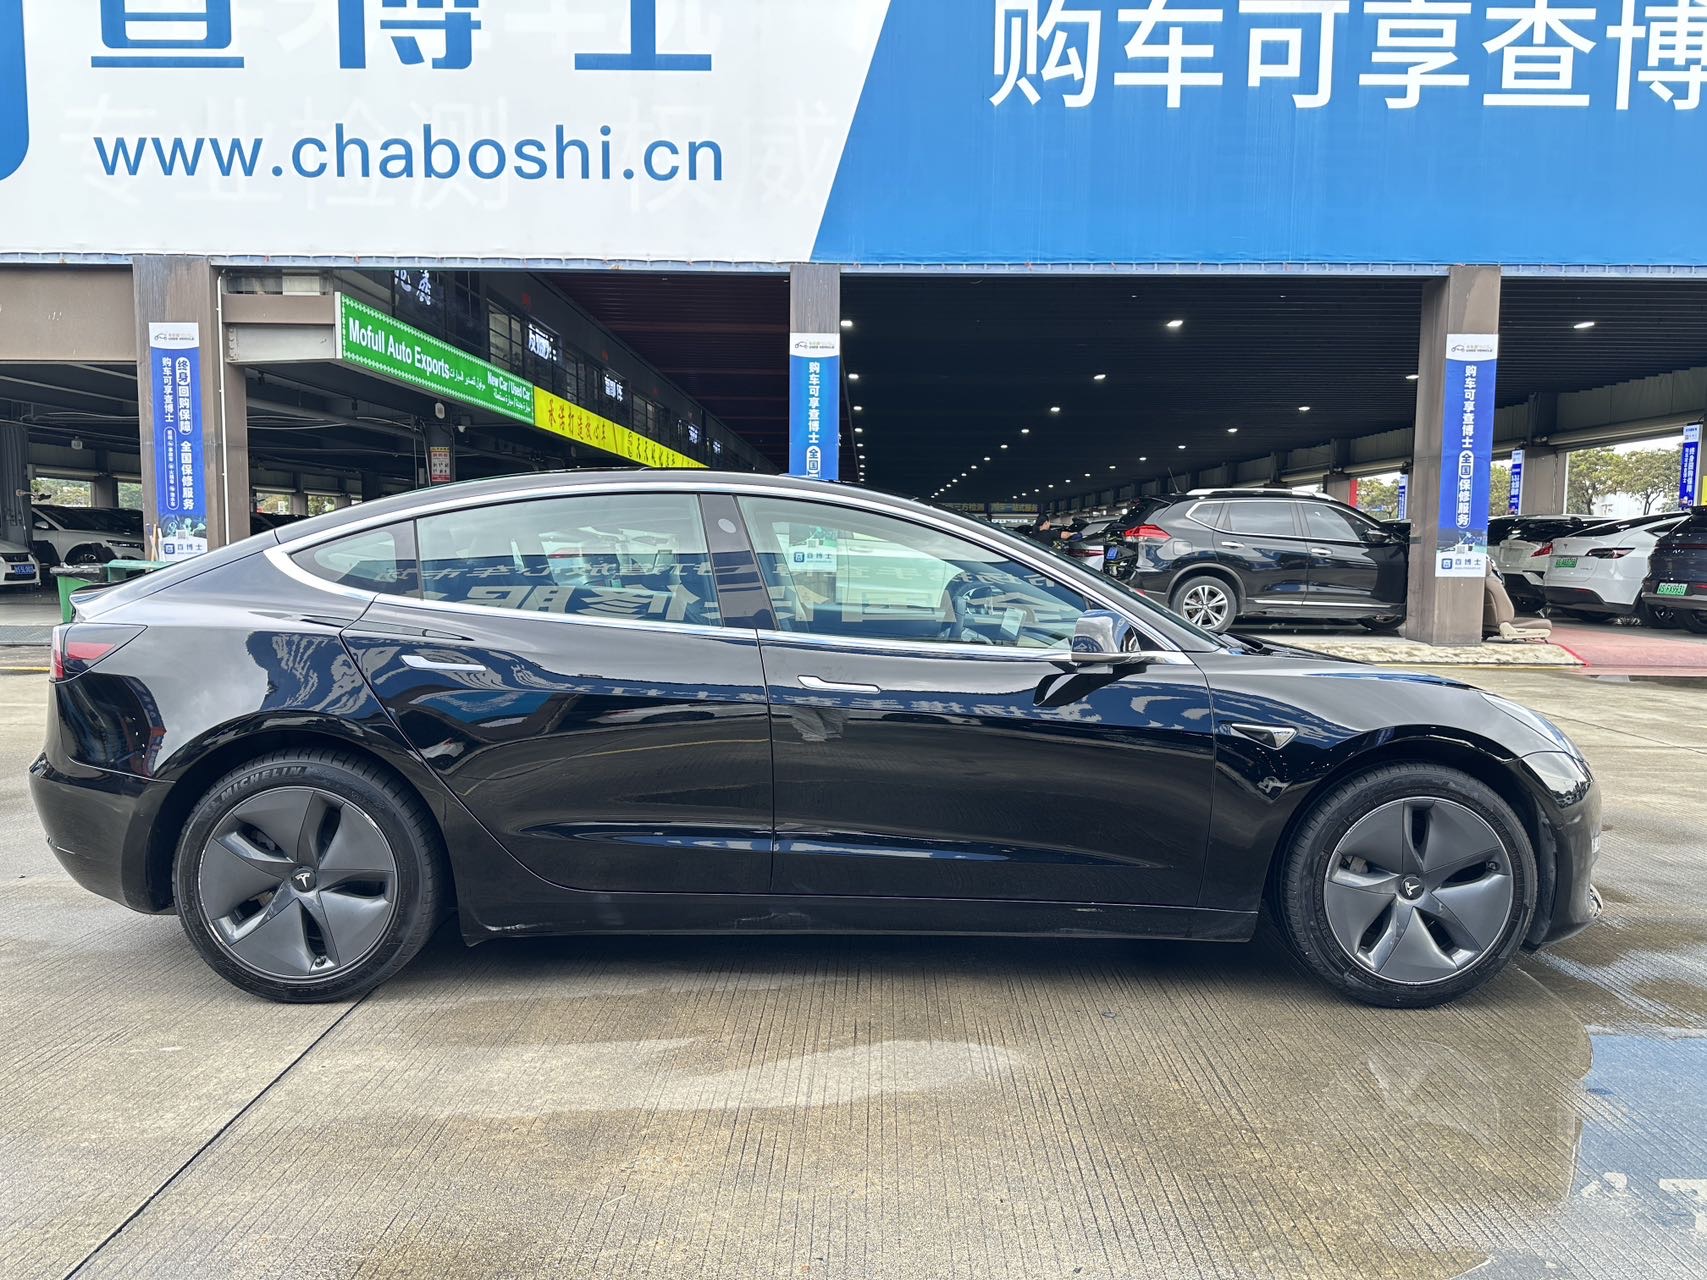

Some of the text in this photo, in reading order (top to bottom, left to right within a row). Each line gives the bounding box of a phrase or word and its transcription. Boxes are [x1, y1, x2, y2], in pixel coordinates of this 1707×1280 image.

[93, 123, 723, 181] www.chaboshi.cn
[349, 317, 450, 380] Mofull Auto Exports
[162, 357, 174, 422] 购车可享查博士
[488, 370, 498, 387] New
[499, 376, 508, 392] Car
[510, 381, 522, 398] Used
[522, 386, 530, 400] Car
[808, 362, 820, 444] 购车可享查博士
[181, 441, 194, 510] 全国保修服务
[1457, 365, 1477, 527] 购车可享查博士 全国保修服务
[221, 766, 302, 801] MICHELIN
